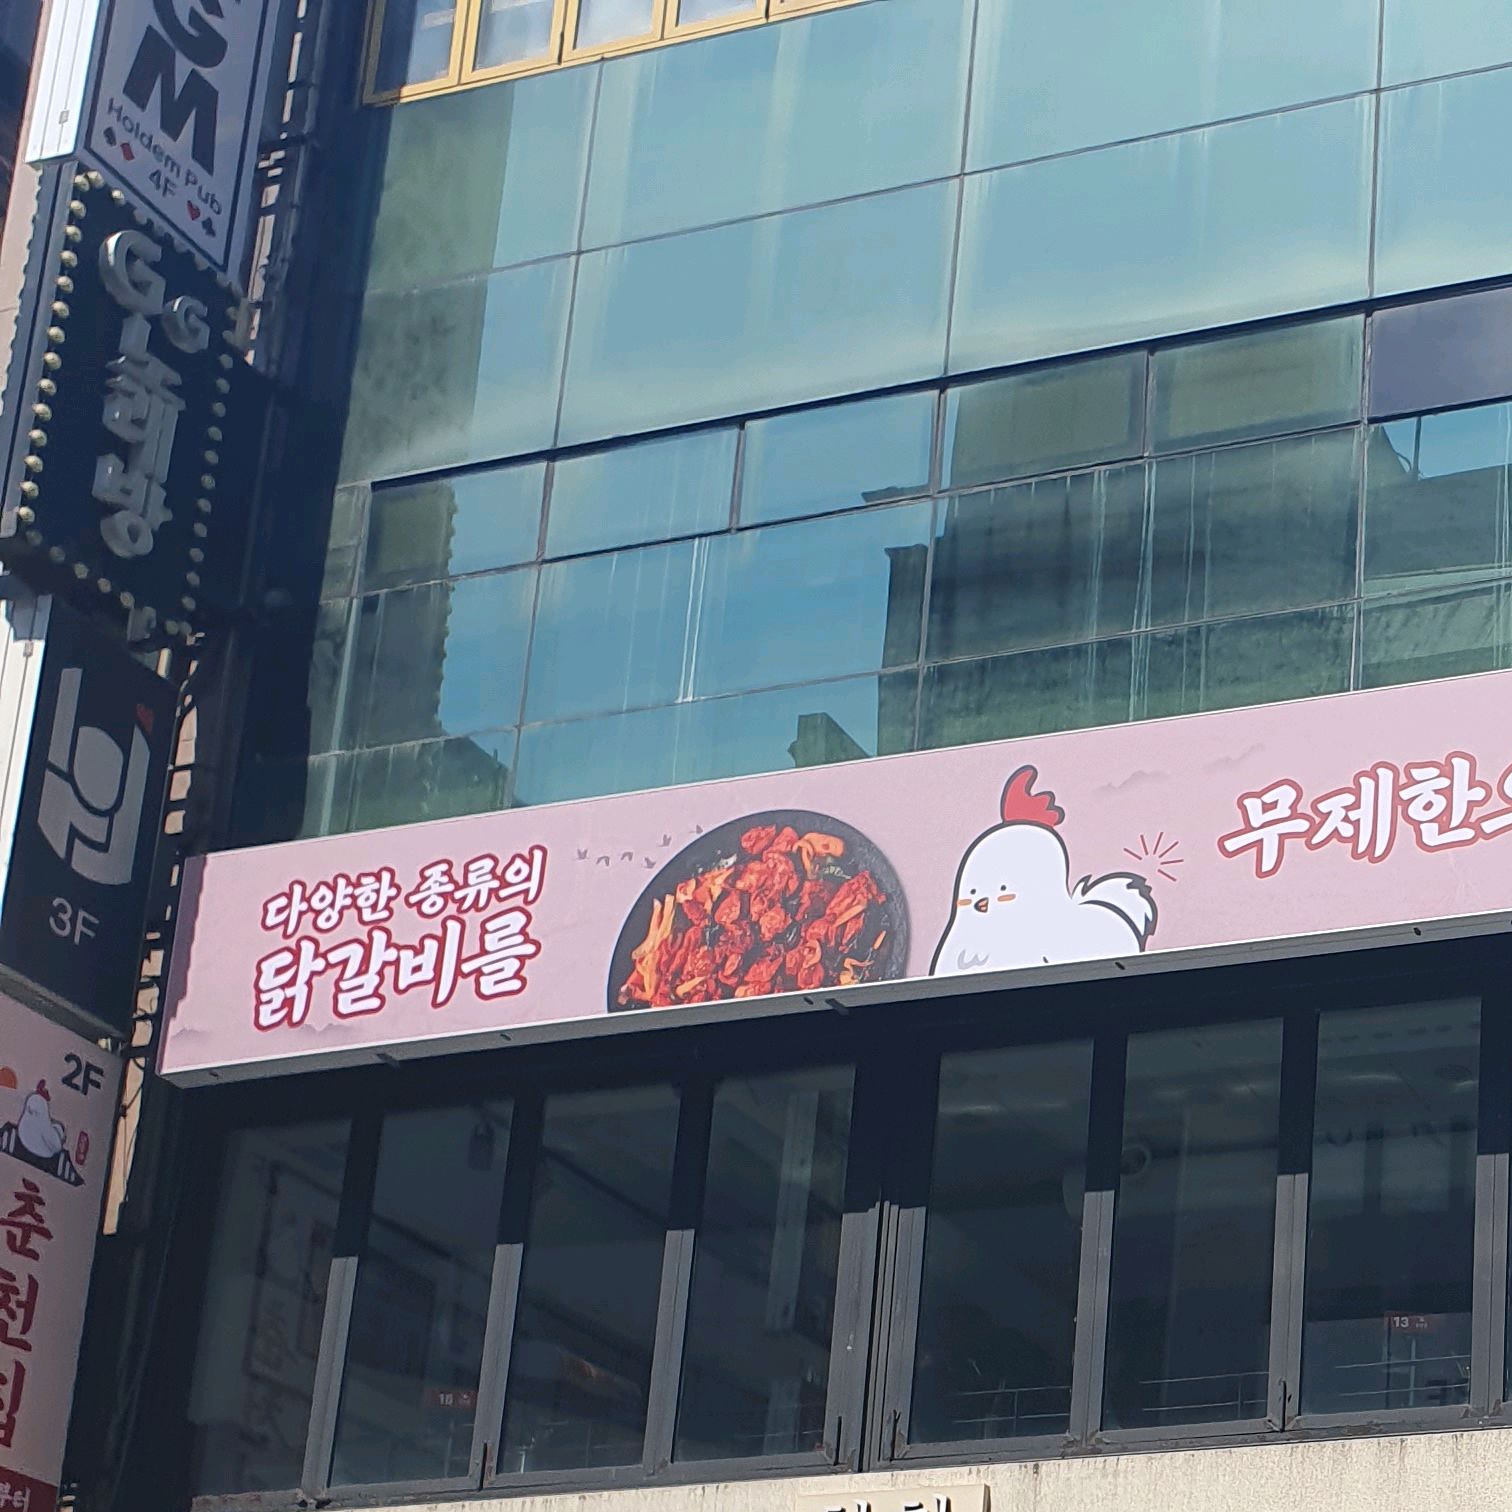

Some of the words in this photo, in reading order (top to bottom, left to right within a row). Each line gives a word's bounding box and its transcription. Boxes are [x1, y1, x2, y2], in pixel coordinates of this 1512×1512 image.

[107, 97, 181, 178] Holdem
[49, 896, 100, 946] 3F
[261, 866, 402, 939] 다양한
[404, 844, 549, 917] 종류의
[253, 905, 543, 1033] 닭갈비를
[61, 1051, 105, 1096] 2F
